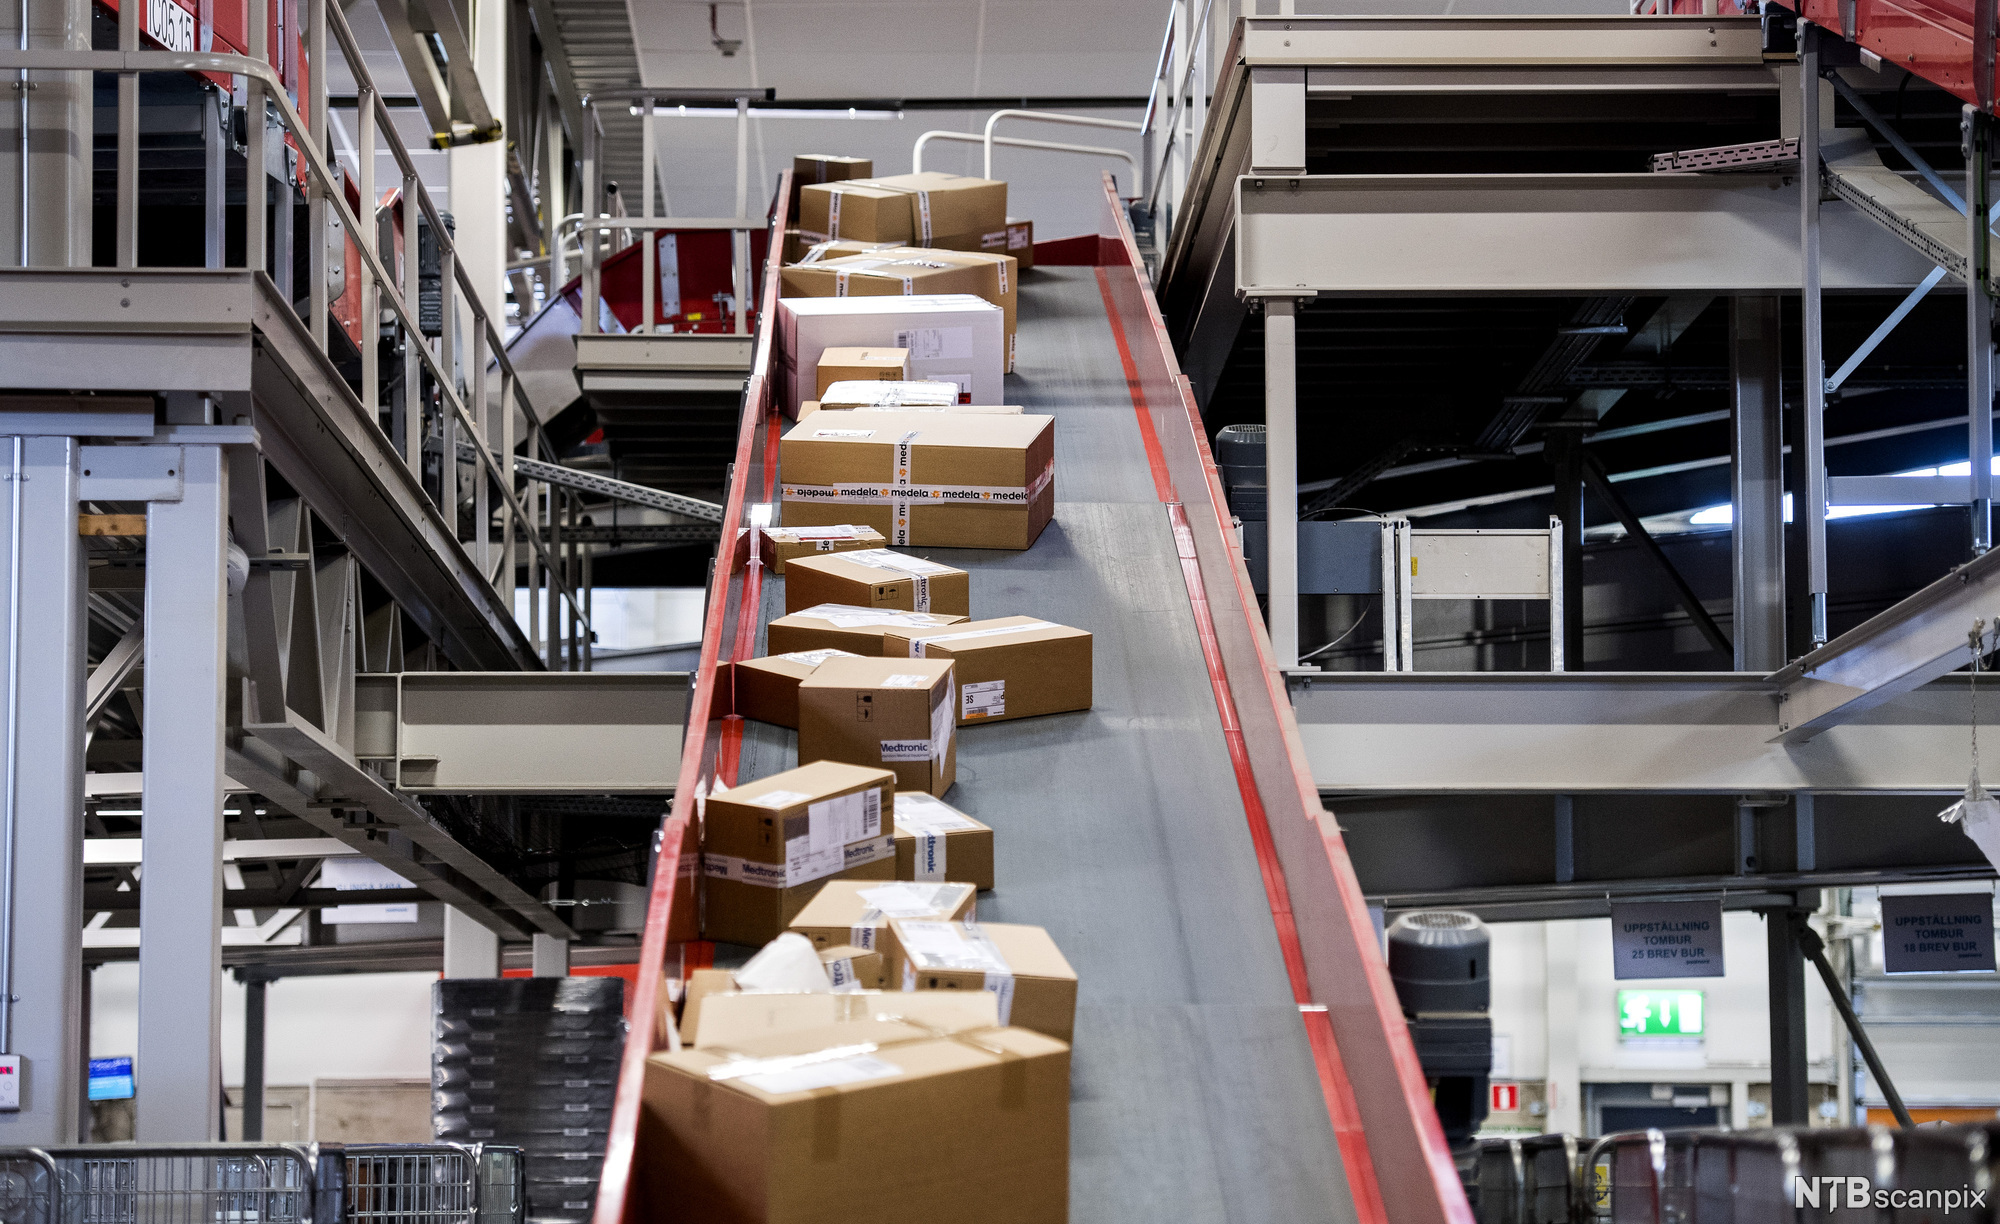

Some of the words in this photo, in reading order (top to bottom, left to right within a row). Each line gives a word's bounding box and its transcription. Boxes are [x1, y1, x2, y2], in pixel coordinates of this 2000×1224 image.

[841, 487, 878, 497] medela
[891, 488, 929, 498] medela
[942, 490, 980, 499] medela
[1895, 913, 1982, 926] UPPSTÄLLNING
[1624, 920, 1710, 933] UPPSTÄLLNING
[1643, 934, 1692, 946] TOMBUR
[1915, 928, 1964, 940] TOMBUR
[1632, 950, 1645, 959] 25
[1647, 948, 1678, 959] BREV
[1681, 947, 1705, 958] BUR
[1904, 943, 1916, 953] 18
[1918, 942, 1950, 953] BREV
[1953, 941, 1977, 952] BUR
